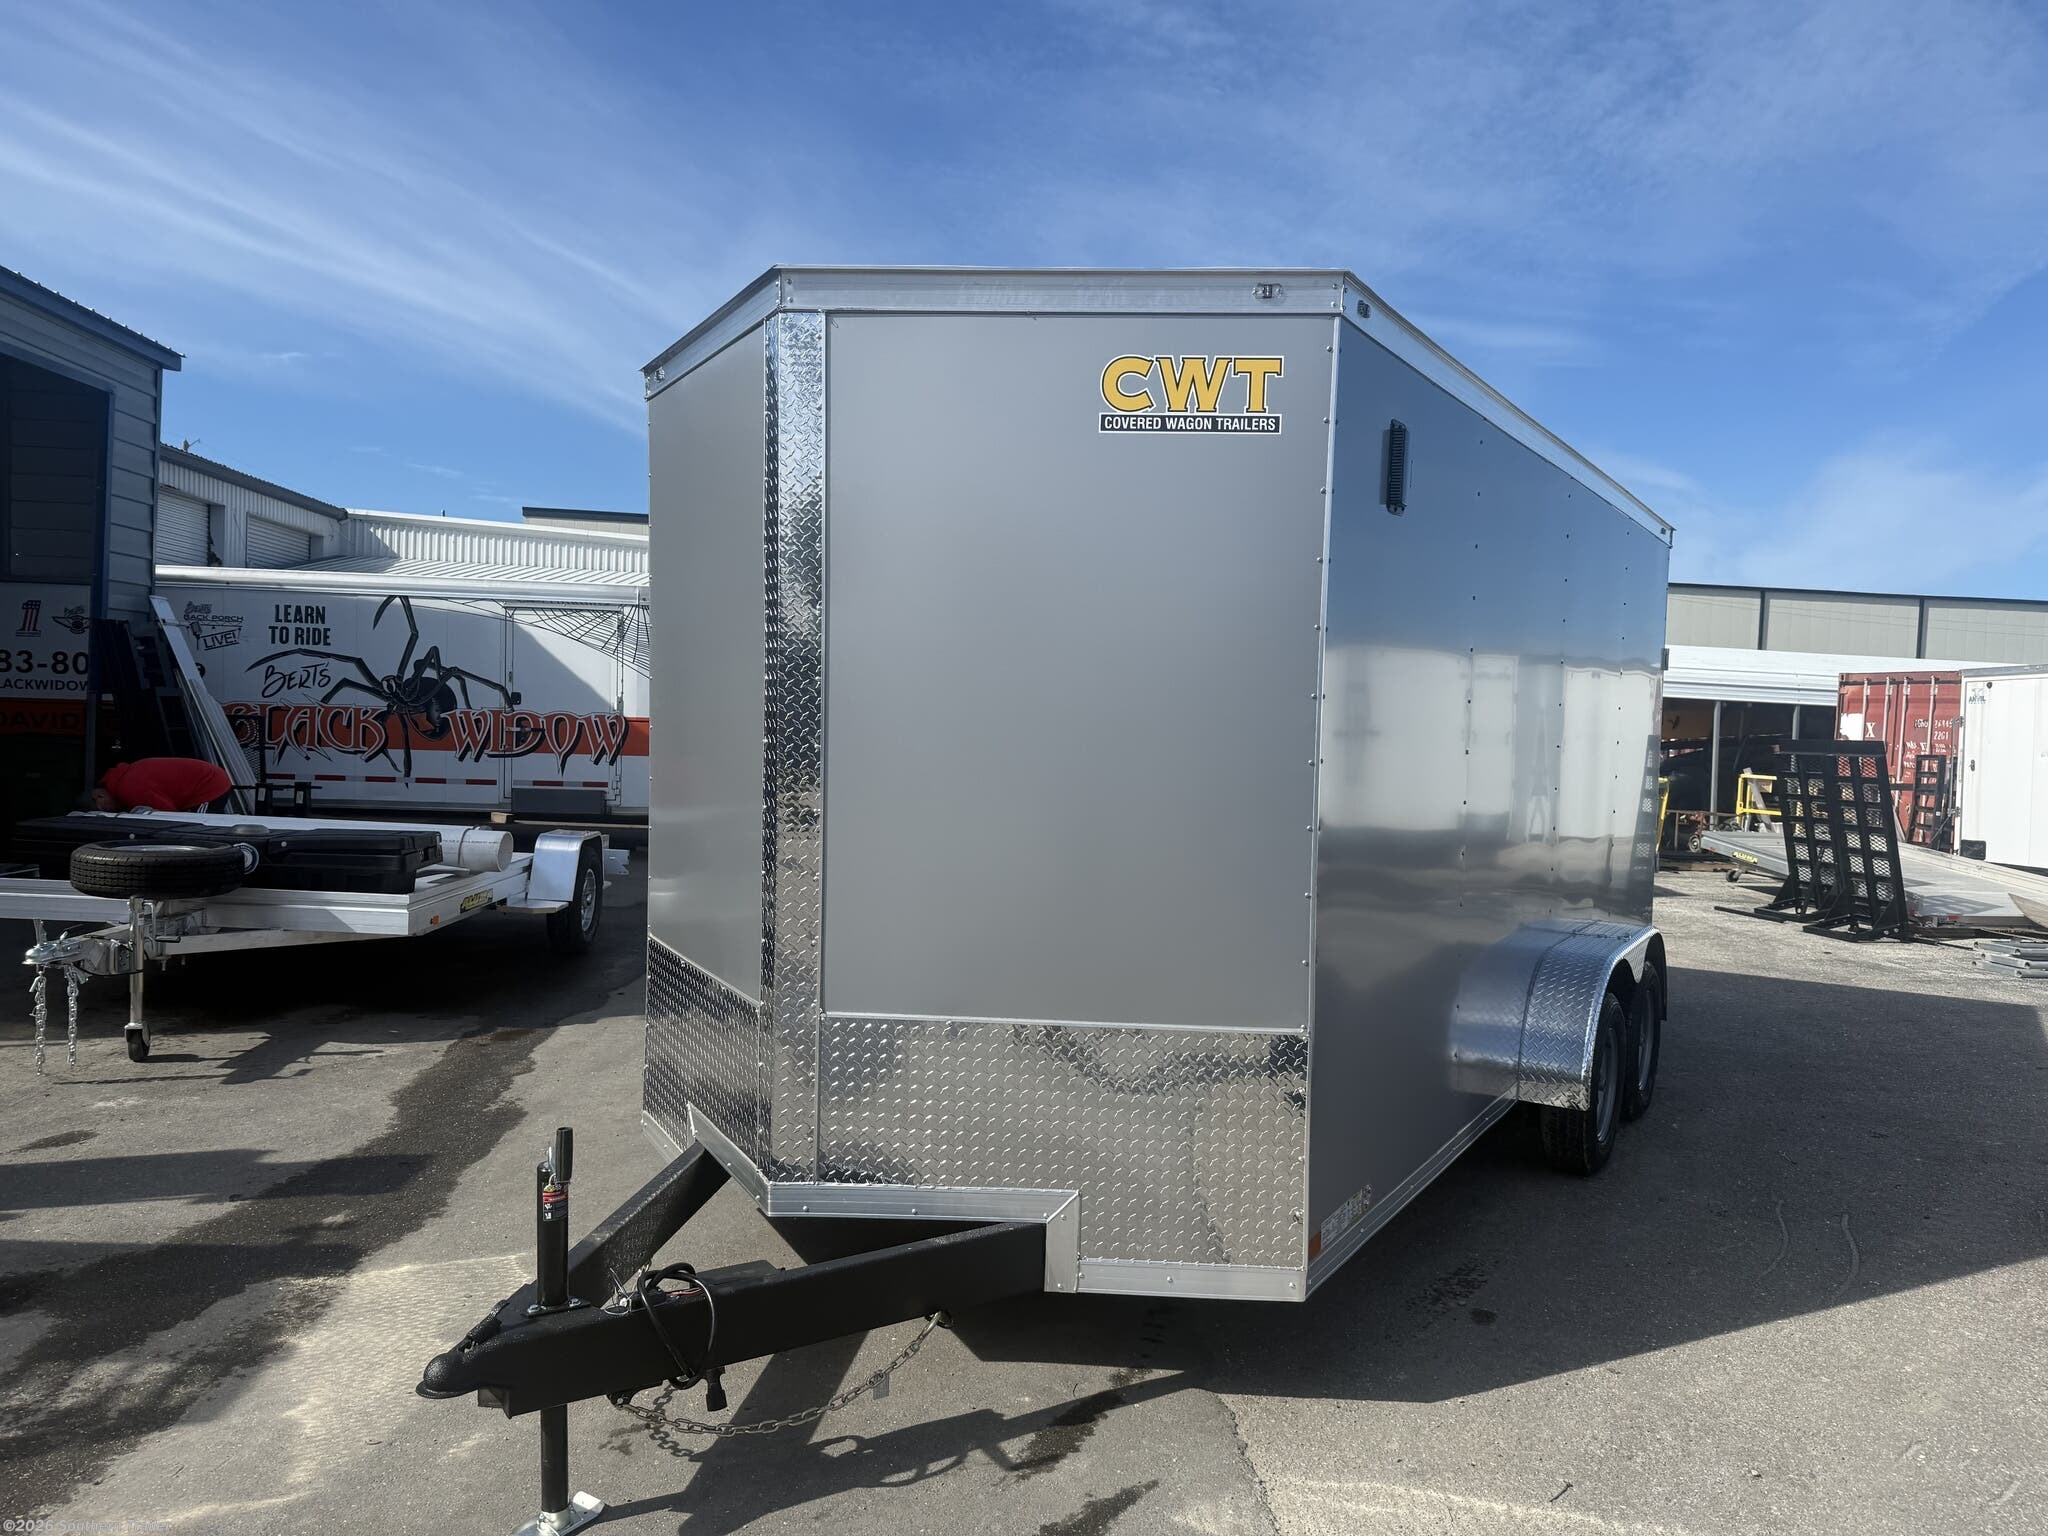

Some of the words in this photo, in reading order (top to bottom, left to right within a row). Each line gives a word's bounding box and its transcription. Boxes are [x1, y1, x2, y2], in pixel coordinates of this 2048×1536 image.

[1101, 355, 1283, 413] CWT
[1104, 416, 1162, 430] COVERED
[1165, 416, 1212, 431] WAGON
[1215, 417, 1276, 431] TRAILERS
[274, 604, 326, 625] LEARN
[203, 632, 237, 648] LIVE!
[269, 626, 288, 645] TO
[294, 627, 332, 646] RIDE
[441, 707, 629, 774] WIDOW
